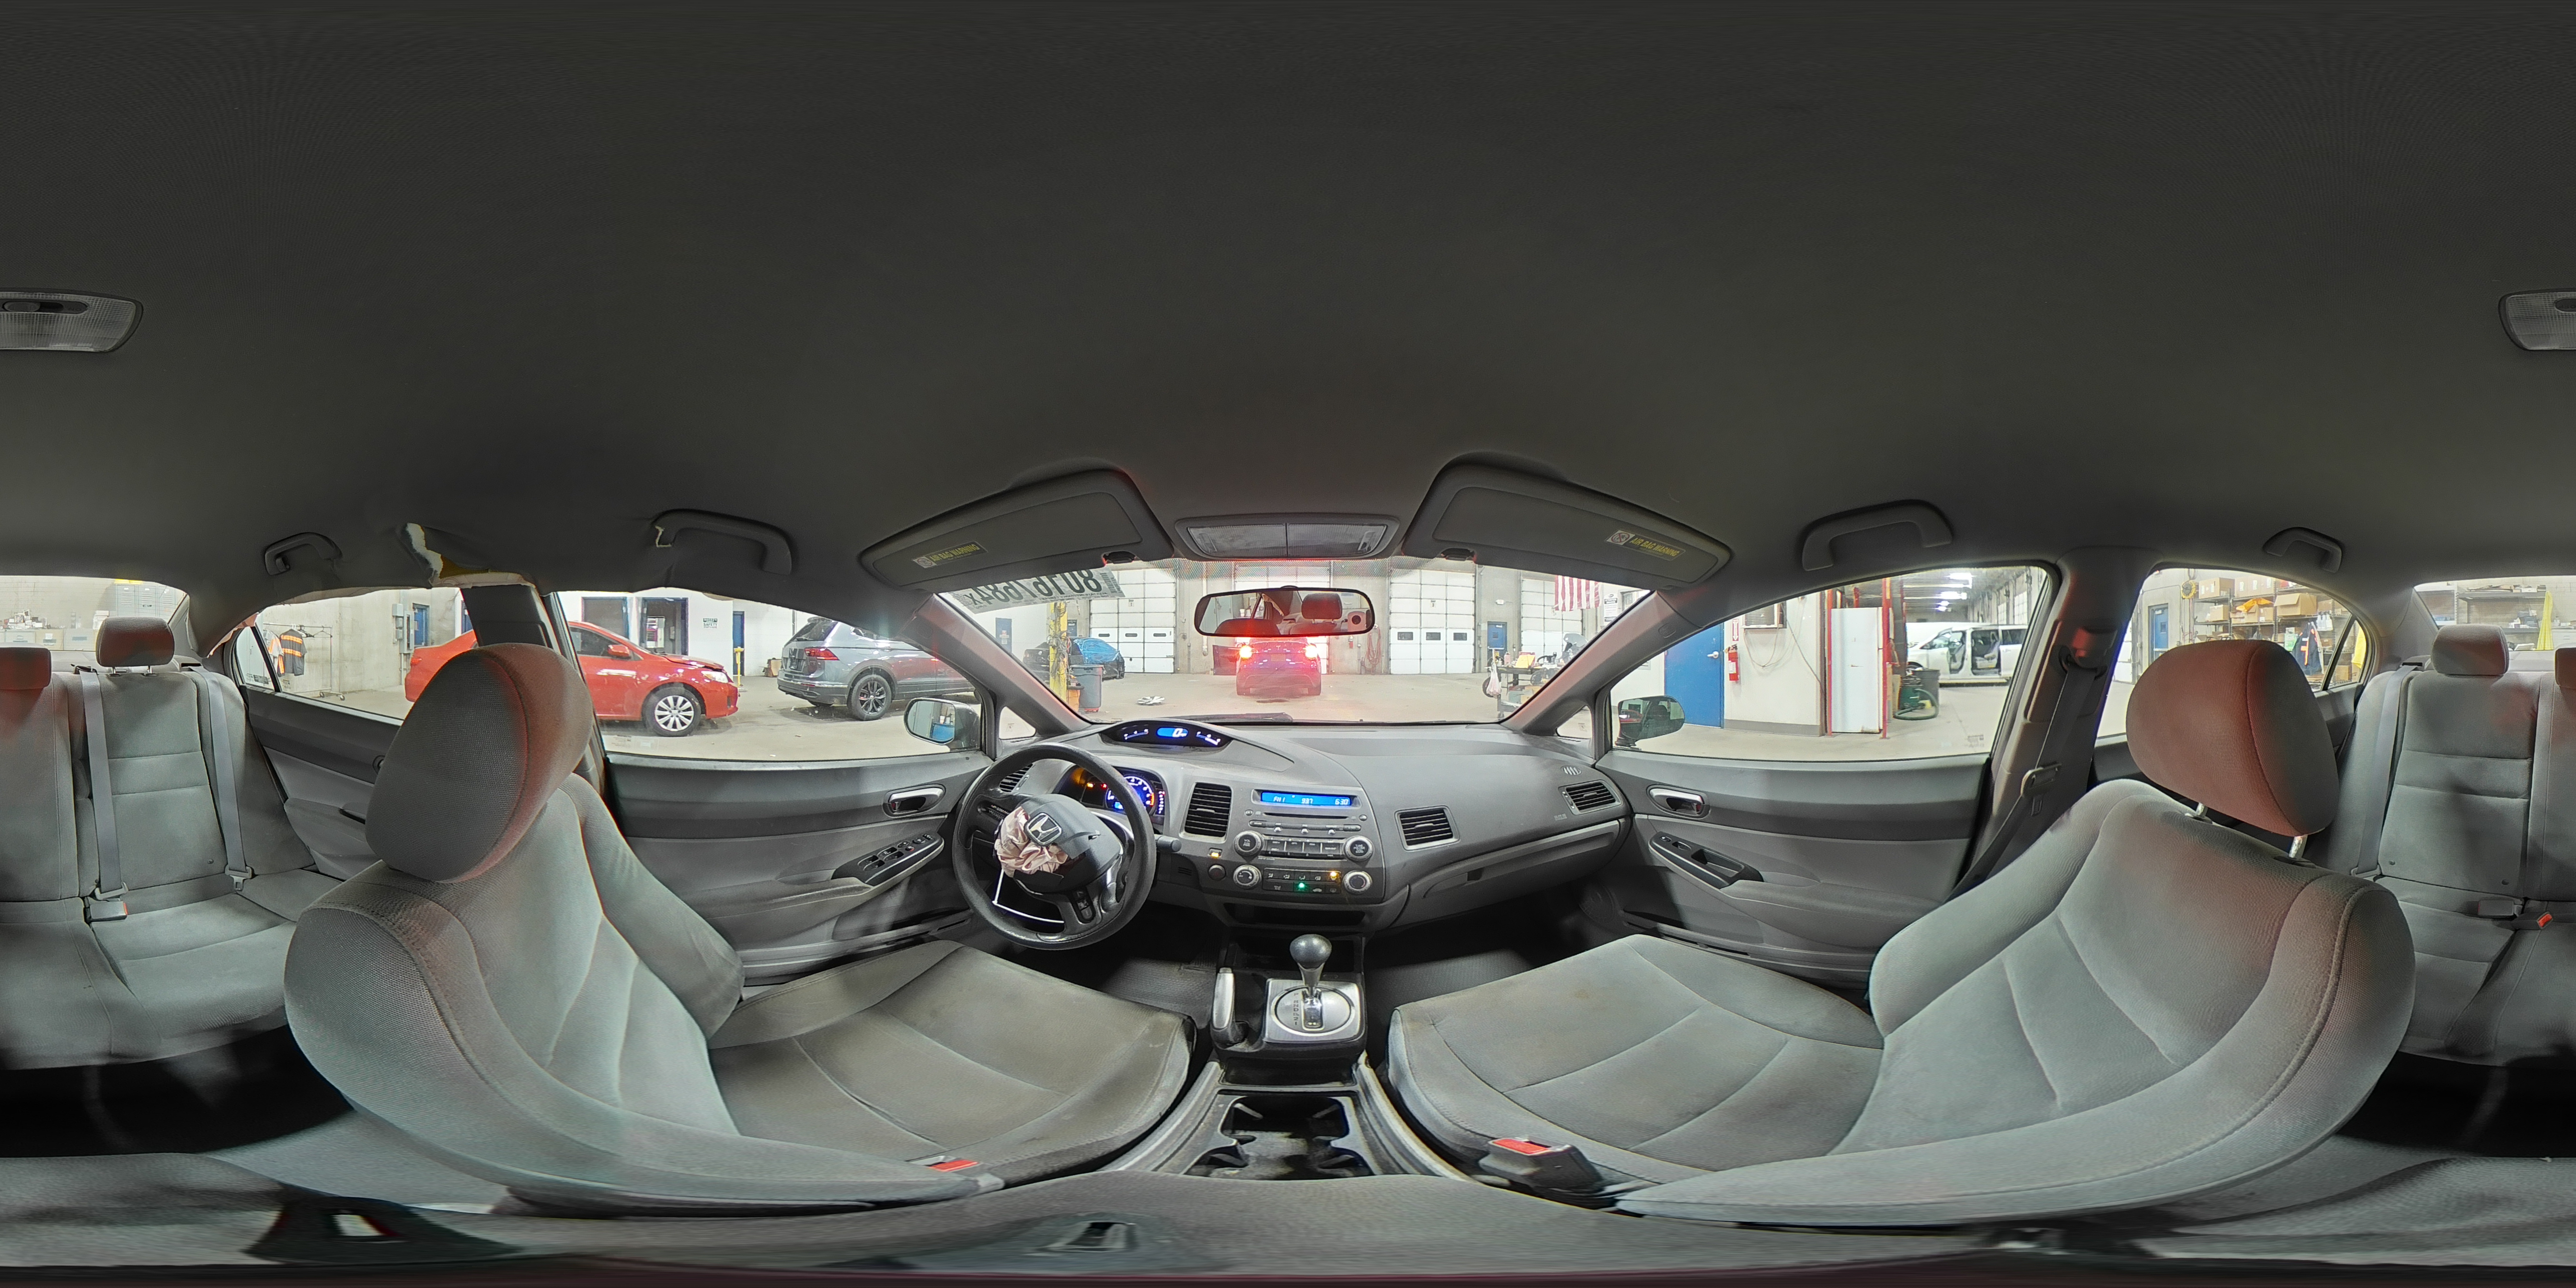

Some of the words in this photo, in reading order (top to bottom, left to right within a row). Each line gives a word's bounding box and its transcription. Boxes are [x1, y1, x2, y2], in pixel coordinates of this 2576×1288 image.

[939, 551, 954, 559] BAG
[949, 544, 980, 556] WARNING
[1640, 541, 1656, 549] BAG
[1653, 544, 1680, 557] WARNING
[1173, 728, 1183, 737] 0
